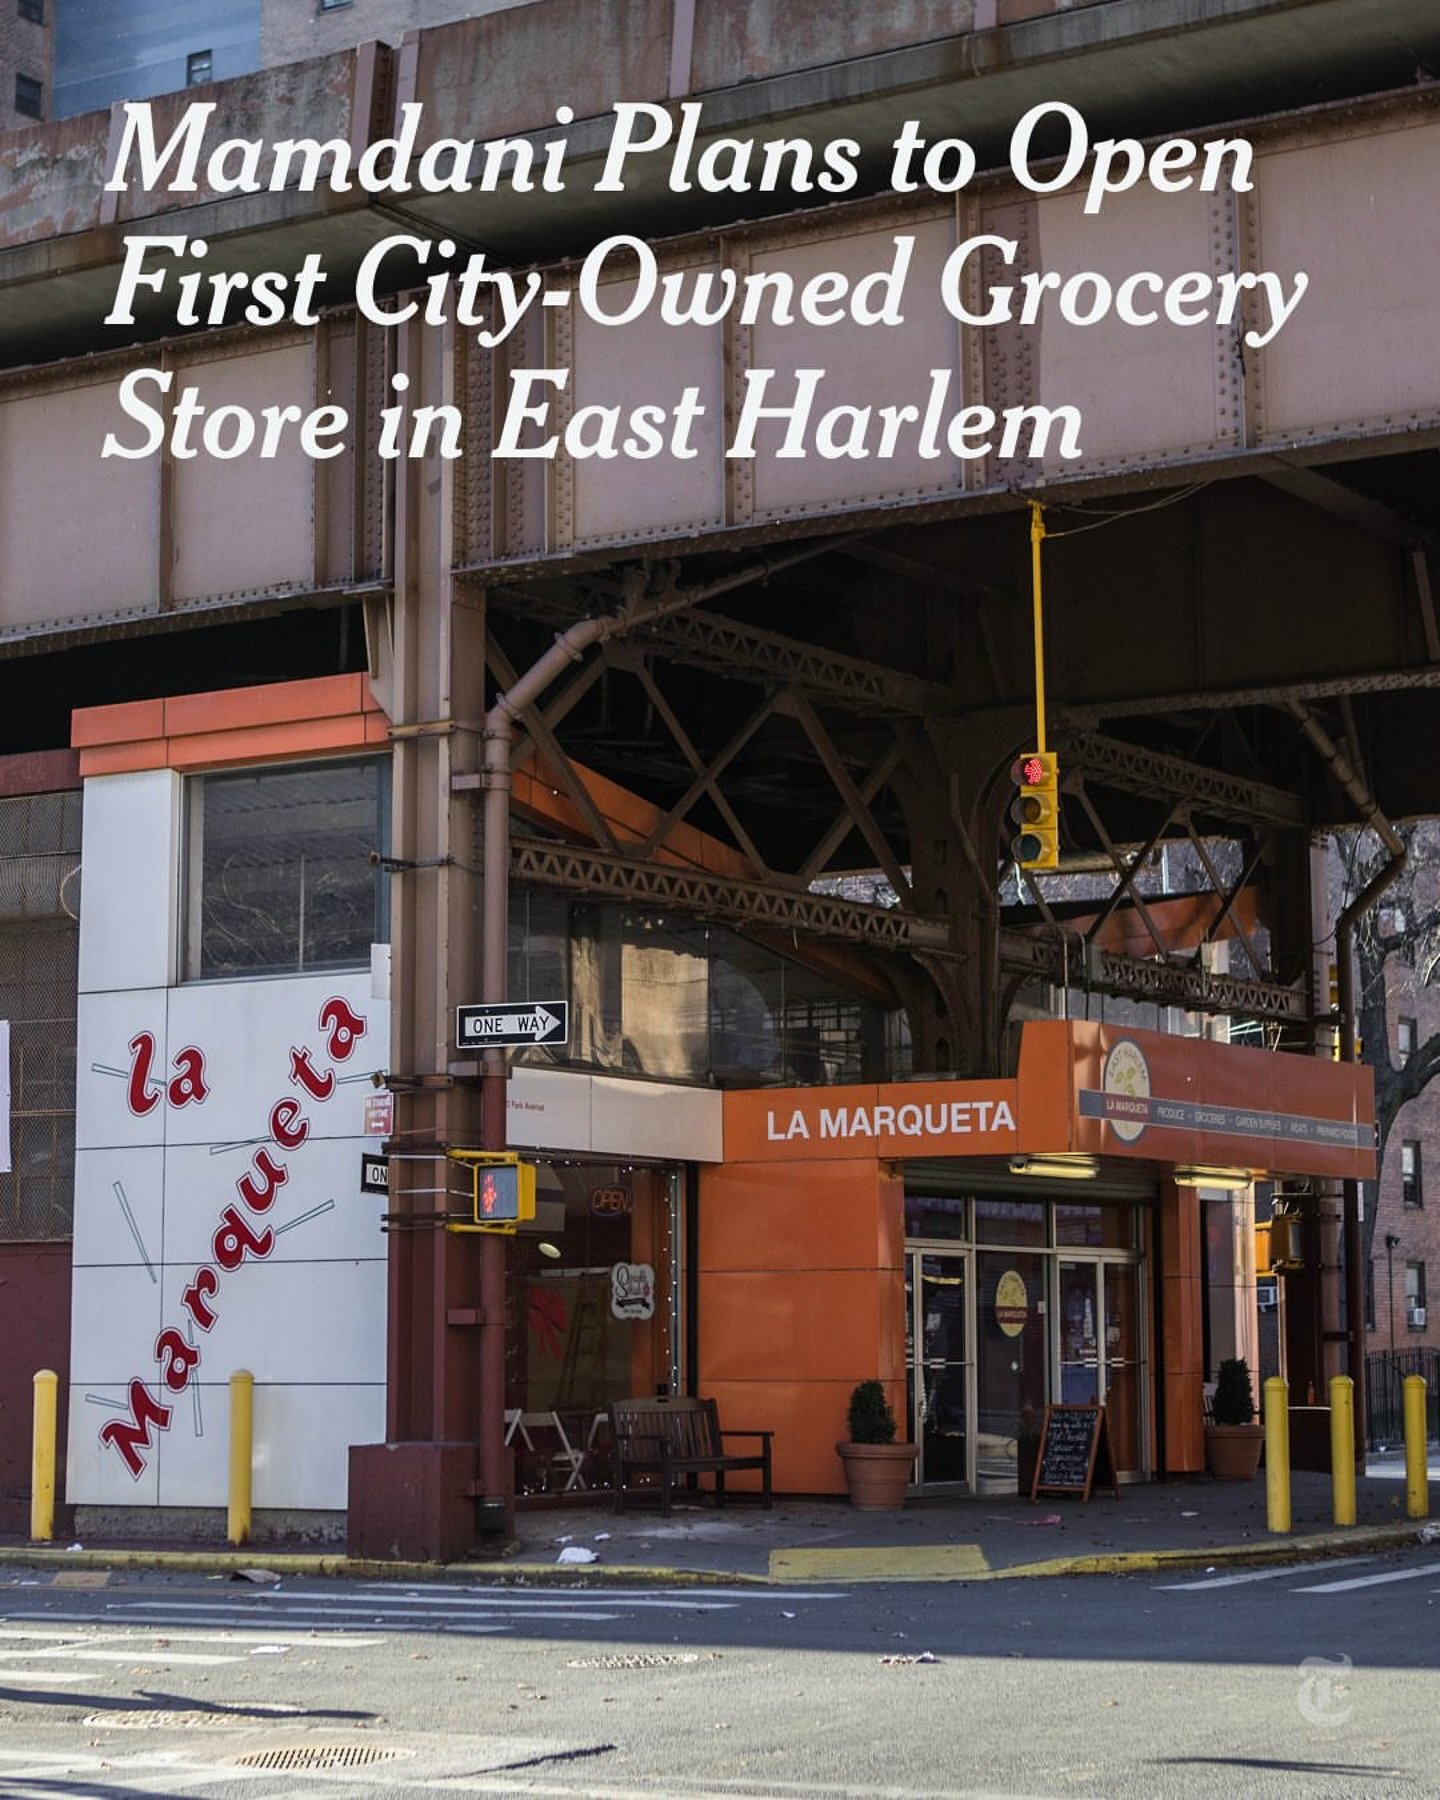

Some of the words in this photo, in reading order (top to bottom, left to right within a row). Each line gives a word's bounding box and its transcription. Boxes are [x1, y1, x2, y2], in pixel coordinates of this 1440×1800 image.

[473, 1017, 503, 1034] ONE
[518, 1015, 549, 1032] WAY
[767, 1109, 810, 1141] LA
[819, 1100, 1016, 1139] MARQUETA
[372, 1166, 388, 1182] ON
[592, 1189, 628, 1210] OPEN
[99, 995, 367, 1481] Marqueta
